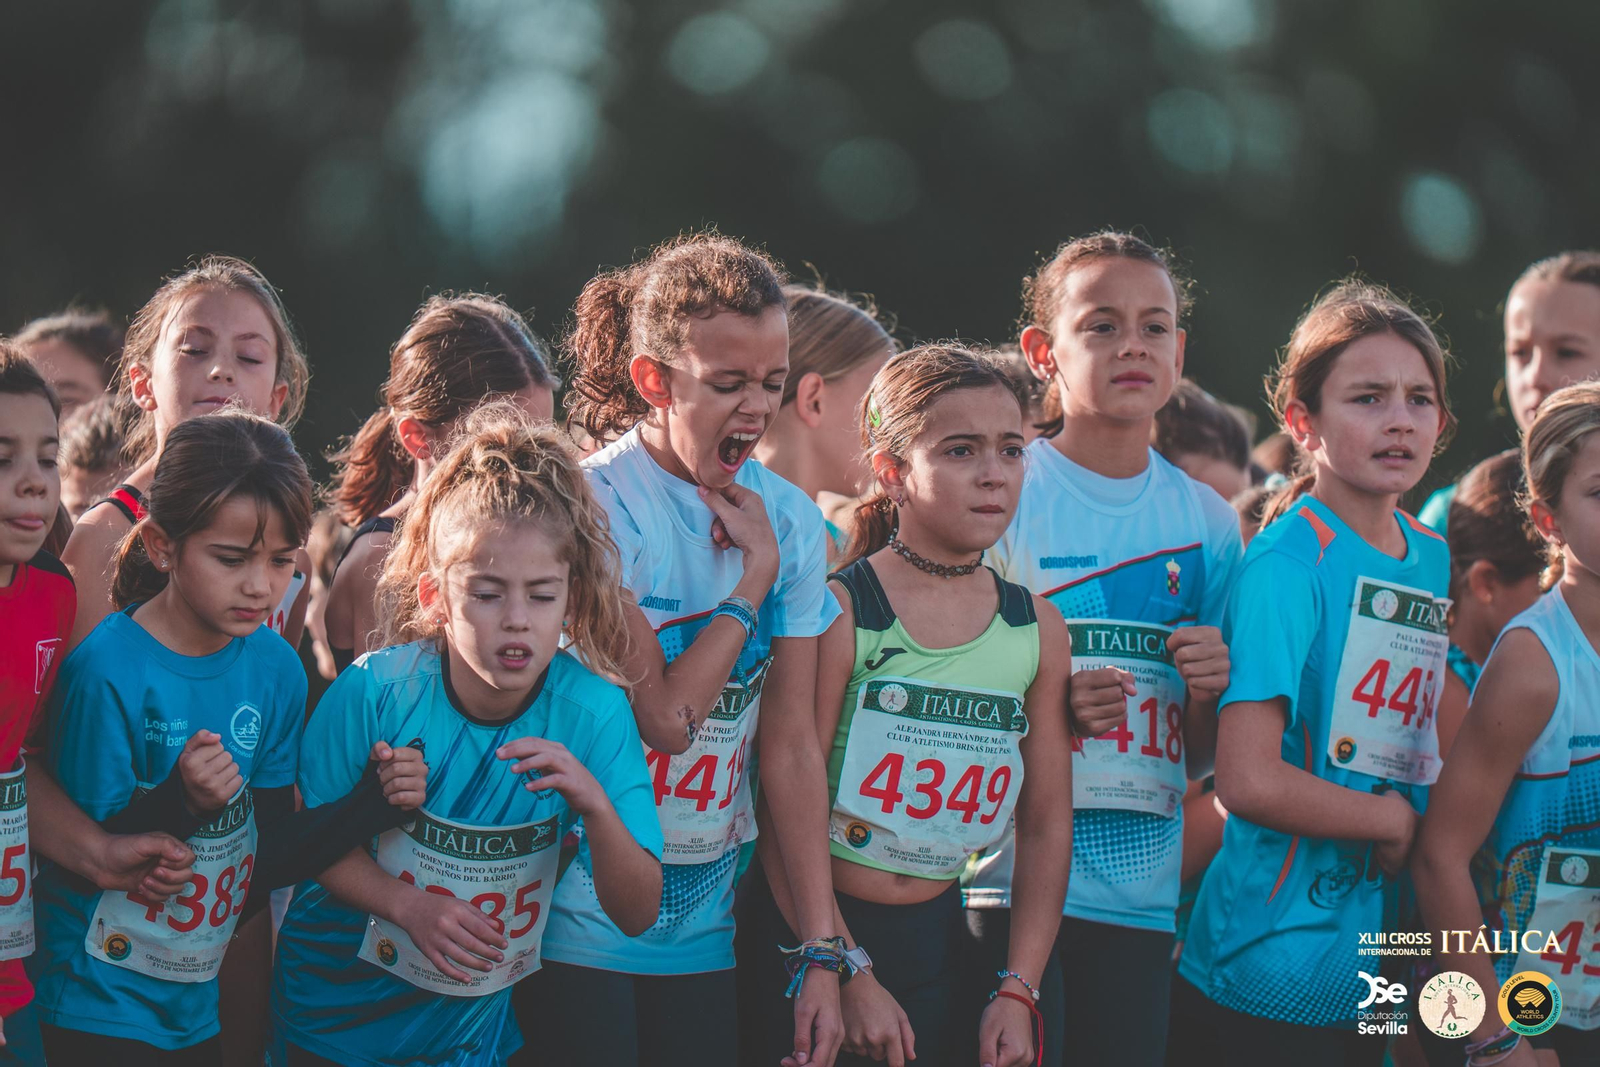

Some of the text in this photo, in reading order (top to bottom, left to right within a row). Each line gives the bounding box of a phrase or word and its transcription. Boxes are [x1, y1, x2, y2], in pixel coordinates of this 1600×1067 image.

[1040, 555, 1098, 569] BORDISPORT
[1086, 627, 1167, 656] ITÁLICA
[921, 692, 1002, 723] ITÁLICA
[145, 718, 168, 732] Los
[894, 724, 941, 738] ALEJANDRA
[942, 731, 989, 744] HERNÁNDEZ
[1071, 695, 1182, 764] 418
[145, 731, 163, 745] del
[699, 734, 718, 744] EDM
[887, 732, 910, 742] CLUB
[912, 737, 955, 749] ATLETISMO
[956, 742, 984, 753] BRISAS
[646, 733, 747, 812] 4419
[859, 752, 1011, 825] 4349
[423, 822, 518, 855] ITÁLICA
[412, 847, 528, 874] CARMEN DEL PINO APARICIO
[419, 861, 516, 883] LOS NIÑOS DEL BARRIO
